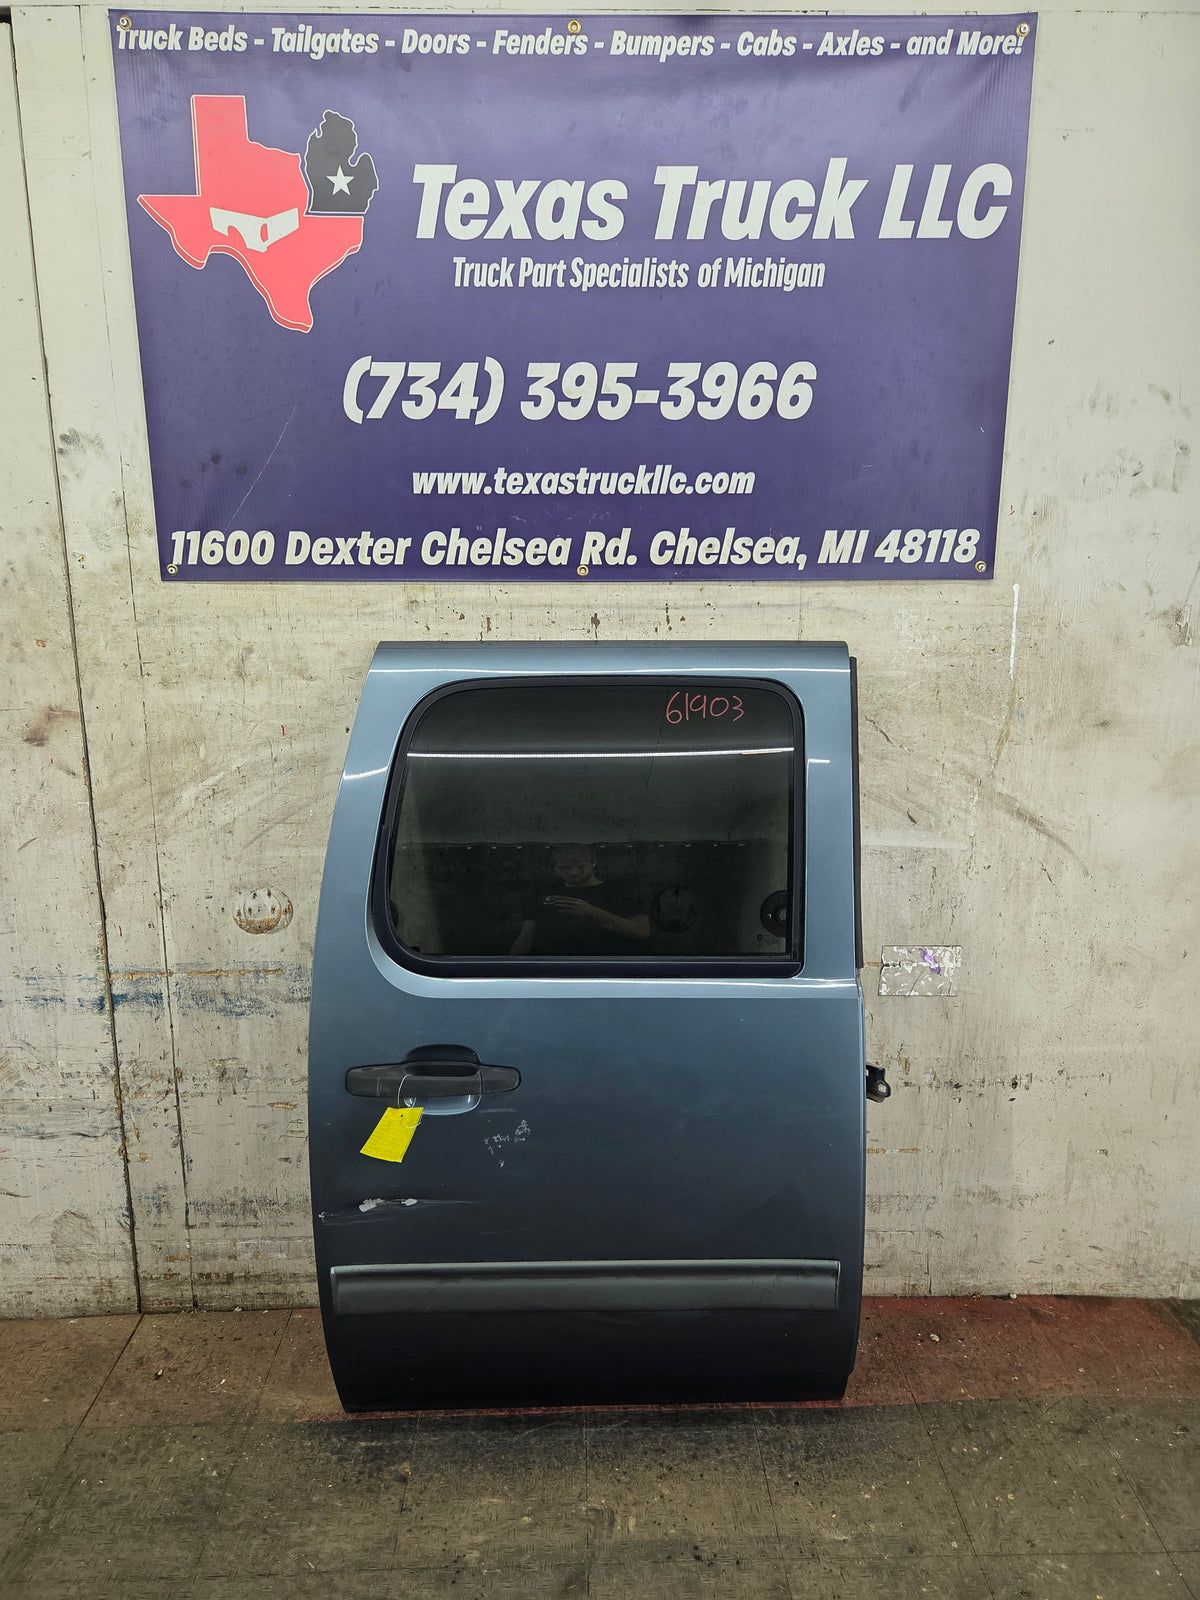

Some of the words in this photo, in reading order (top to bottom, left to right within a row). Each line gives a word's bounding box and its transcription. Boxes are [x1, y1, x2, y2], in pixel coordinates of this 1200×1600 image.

[116, 24, 183, 51] Truck
[188, 24, 249, 52] Beds
[272, 24, 380, 61] Tailgates
[402, 29, 471, 55] Doors
[493, 28, 589, 56] Fenders
[610, 30, 716, 63] Bumpers
[737, 29, 798, 57] Cabs
[817, 29, 885, 56] Axles
[907, 29, 955, 56] and
[957, 31, 1025, 56] More!
[412, 163, 629, 241] Texas
[653, 156, 869, 241] Truck
[877, 162, 1013, 240] LLC
[452, 256, 515, 288] Truck
[518, 256, 567, 288] Part
[569, 256, 690, 292] Specialists
[697, 257, 723, 288] of
[723, 256, 826, 292] Michigan
[342, 355, 505, 426] (734)
[520, 361, 818, 421] 395-3966
[412, 464, 756, 495] www.texastruckllc.com
[170, 530, 275, 566] 11600
[284, 530, 413, 566] Dexter
[421, 527, 572, 566] Chelsea
[579, 527, 638, 566] Rd.
[649, 527, 808, 571] Chelsea,
[817, 529, 870, 564] MI
[873, 528, 981, 564] 48118
[666, 691, 744, 724] 61903
